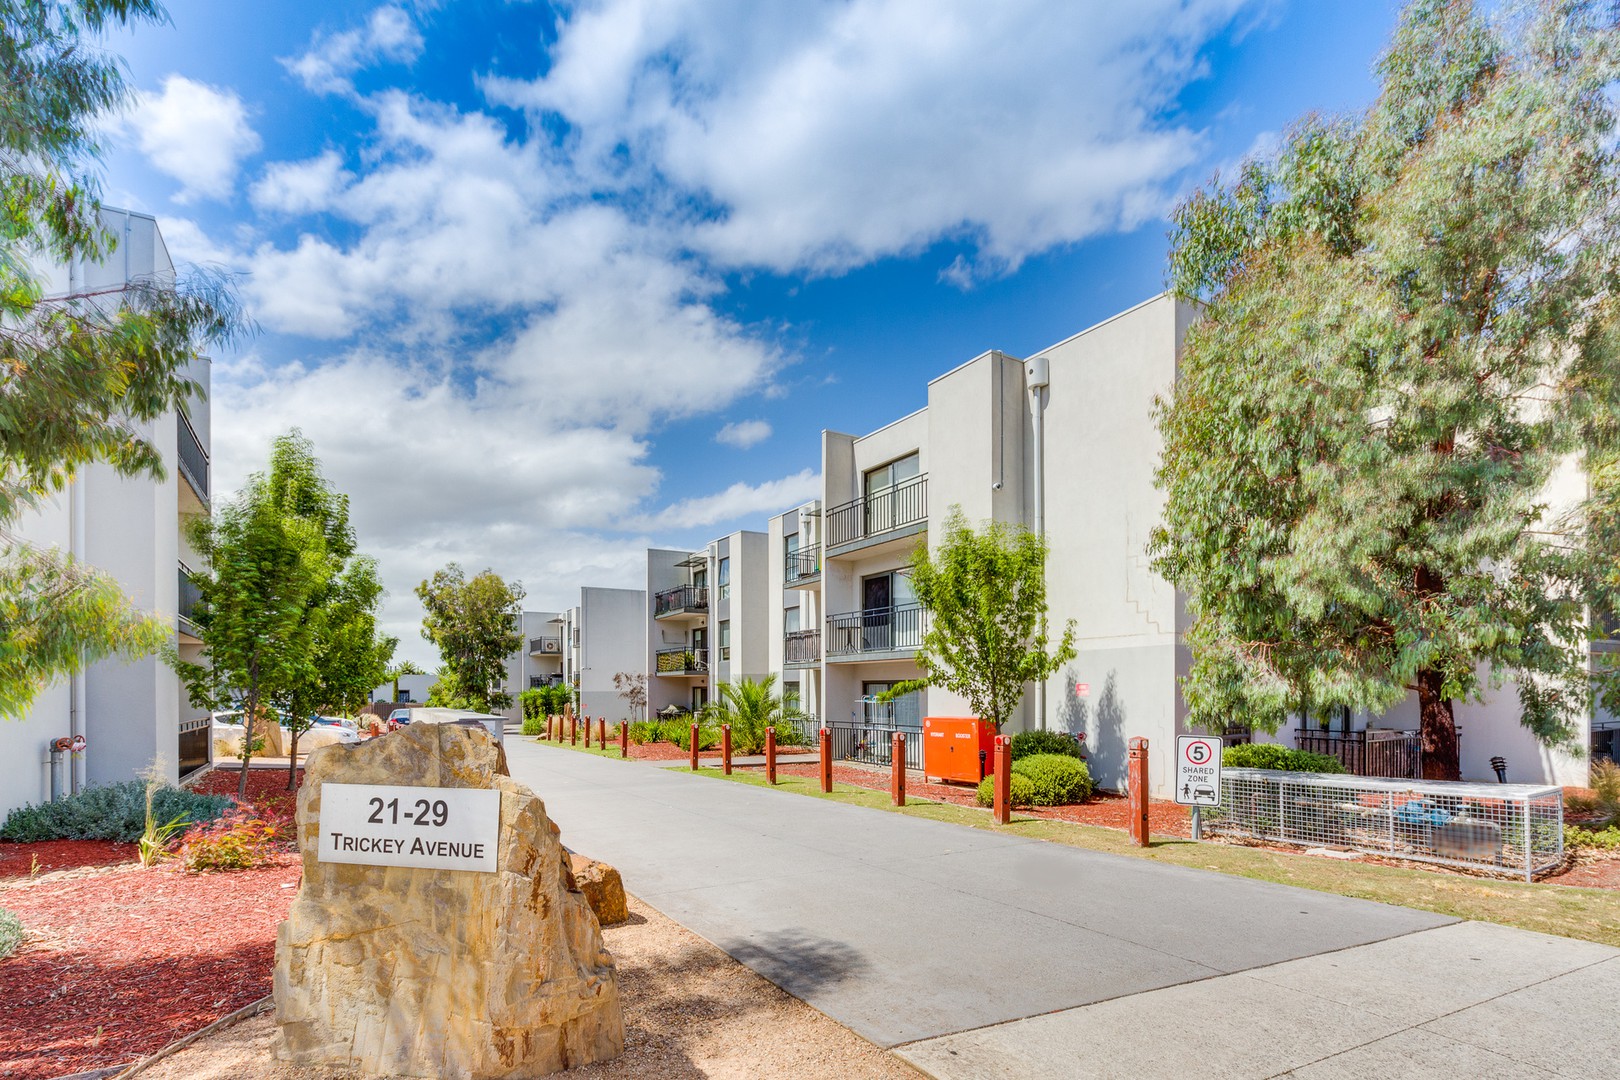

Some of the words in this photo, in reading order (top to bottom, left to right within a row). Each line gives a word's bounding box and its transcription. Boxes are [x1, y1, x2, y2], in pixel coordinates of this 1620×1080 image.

[1193, 746, 1204, 761] 5
[1182, 766, 1215, 775] SHARED
[1187, 775, 1209, 783] ZONE
[368, 797, 449, 827] 21-29
